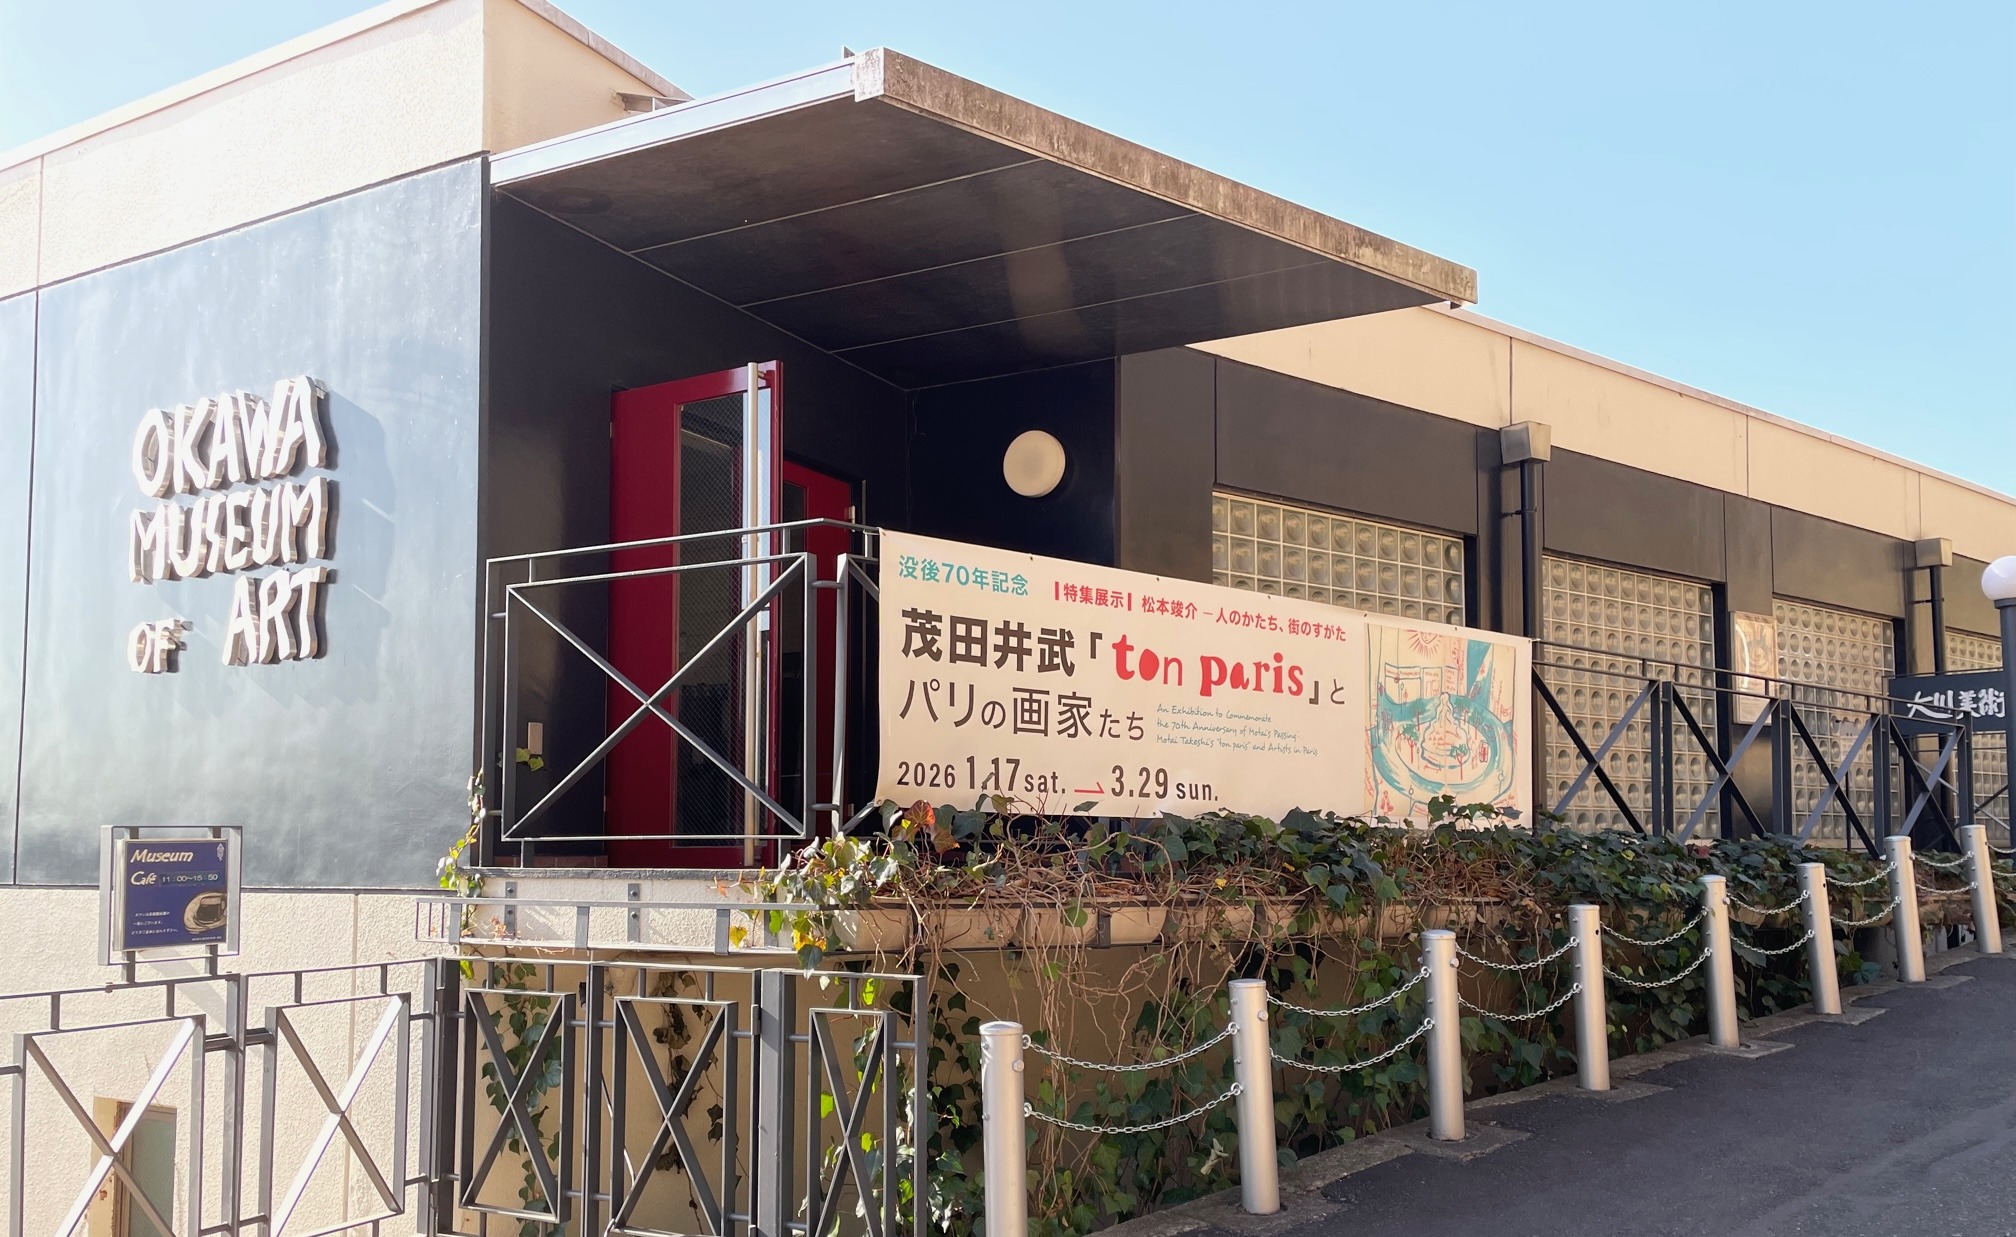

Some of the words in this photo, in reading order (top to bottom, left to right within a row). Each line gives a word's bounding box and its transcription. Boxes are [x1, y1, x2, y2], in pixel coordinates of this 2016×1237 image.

[131, 375, 327, 498] OKAWA
[129, 475, 327, 583] MUSEUM
[898, 554, 1029, 597] 没後70年記念
[127, 618, 182, 674] OF
[222, 566, 327, 666] ART
[899, 678, 1146, 742] パリの画家たち
[1157, 703, 1169, 713] An
[1172, 705, 1214, 717] Exhibition
[1215, 708, 1223, 718] to
[1226, 710, 1272, 723] Commemorate
[1157, 719, 1169, 729] the
[1172, 722, 1190, 731] 70th
[1192, 722, 1238, 737] Anniversary
[1240, 725, 1248, 737] of
[1157, 734, 1178, 744] Motai
[1252, 743, 1266, 752] and
[1268, 743, 1291, 755] Artists
[1293, 746, 1302, 754] in
[1302, 746, 1318, 757] Paris
[896, 760, 956, 789] 2026
[1024, 771, 1067, 794] sat.
[1111, 765, 1169, 800] 3.29
[1176, 780, 1219, 802] sun.
[130, 849, 194, 864] Museum
